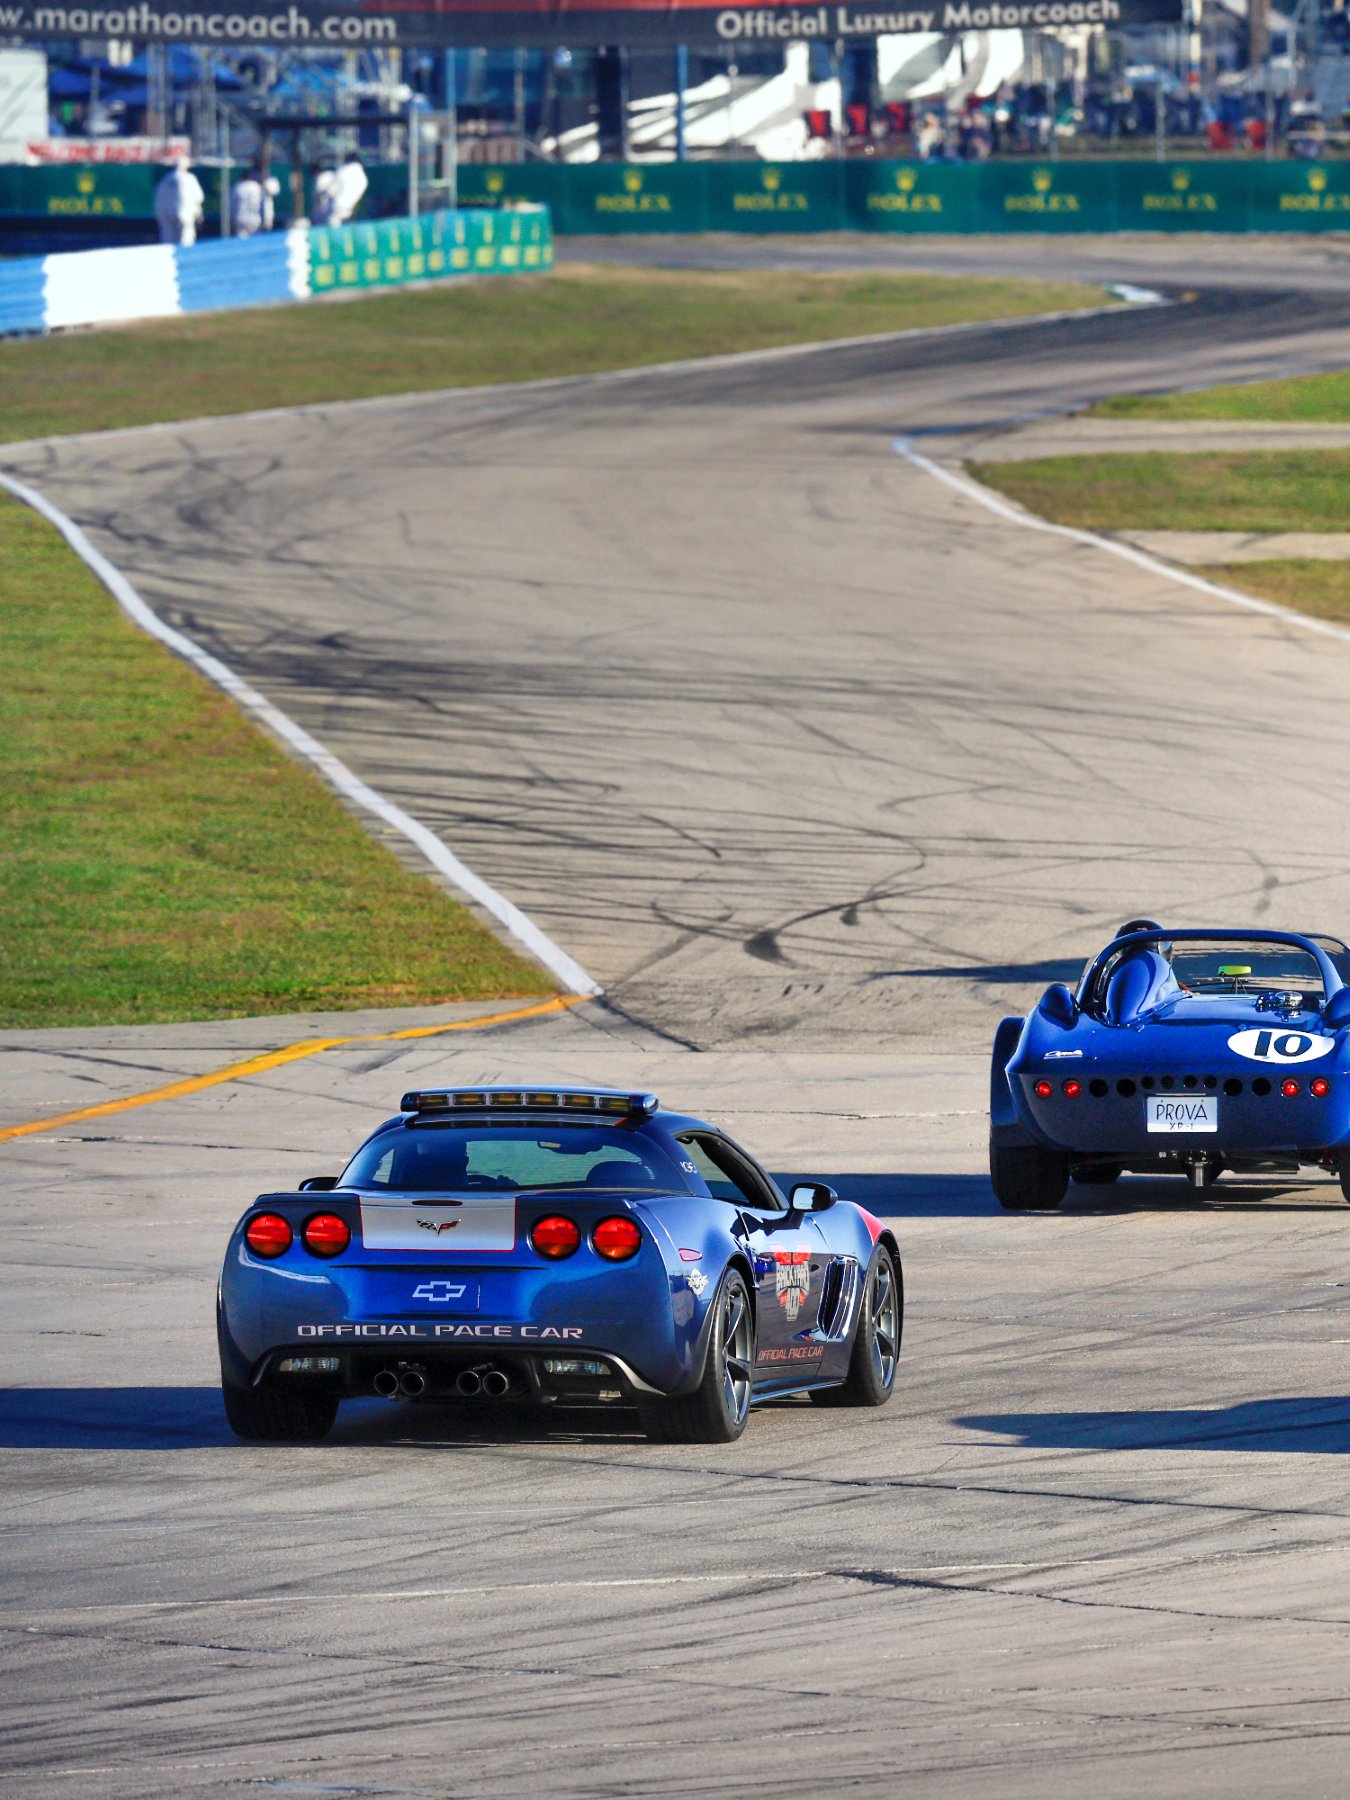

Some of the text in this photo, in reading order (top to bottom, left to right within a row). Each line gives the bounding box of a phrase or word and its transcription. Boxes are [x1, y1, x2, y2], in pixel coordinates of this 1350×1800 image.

[716, 0, 1120, 38] Official Luxury Motorcoach
[597, 195, 670, 212] ROLEX
[734, 195, 807, 211] ROLEX
[869, 195, 941, 212] ROLEX
[1005, 195, 1078, 212] ROLEX
[1143, 195, 1216, 211] ROLEX
[1253, 1030, 1313, 1057] 10
[1156, 1103, 1208, 1121] PROVA
[297, 1324, 583, 1340] OFFICIAL PACE CAR
[758, 1345, 824, 1361] OFFICIAL PACE CAR
